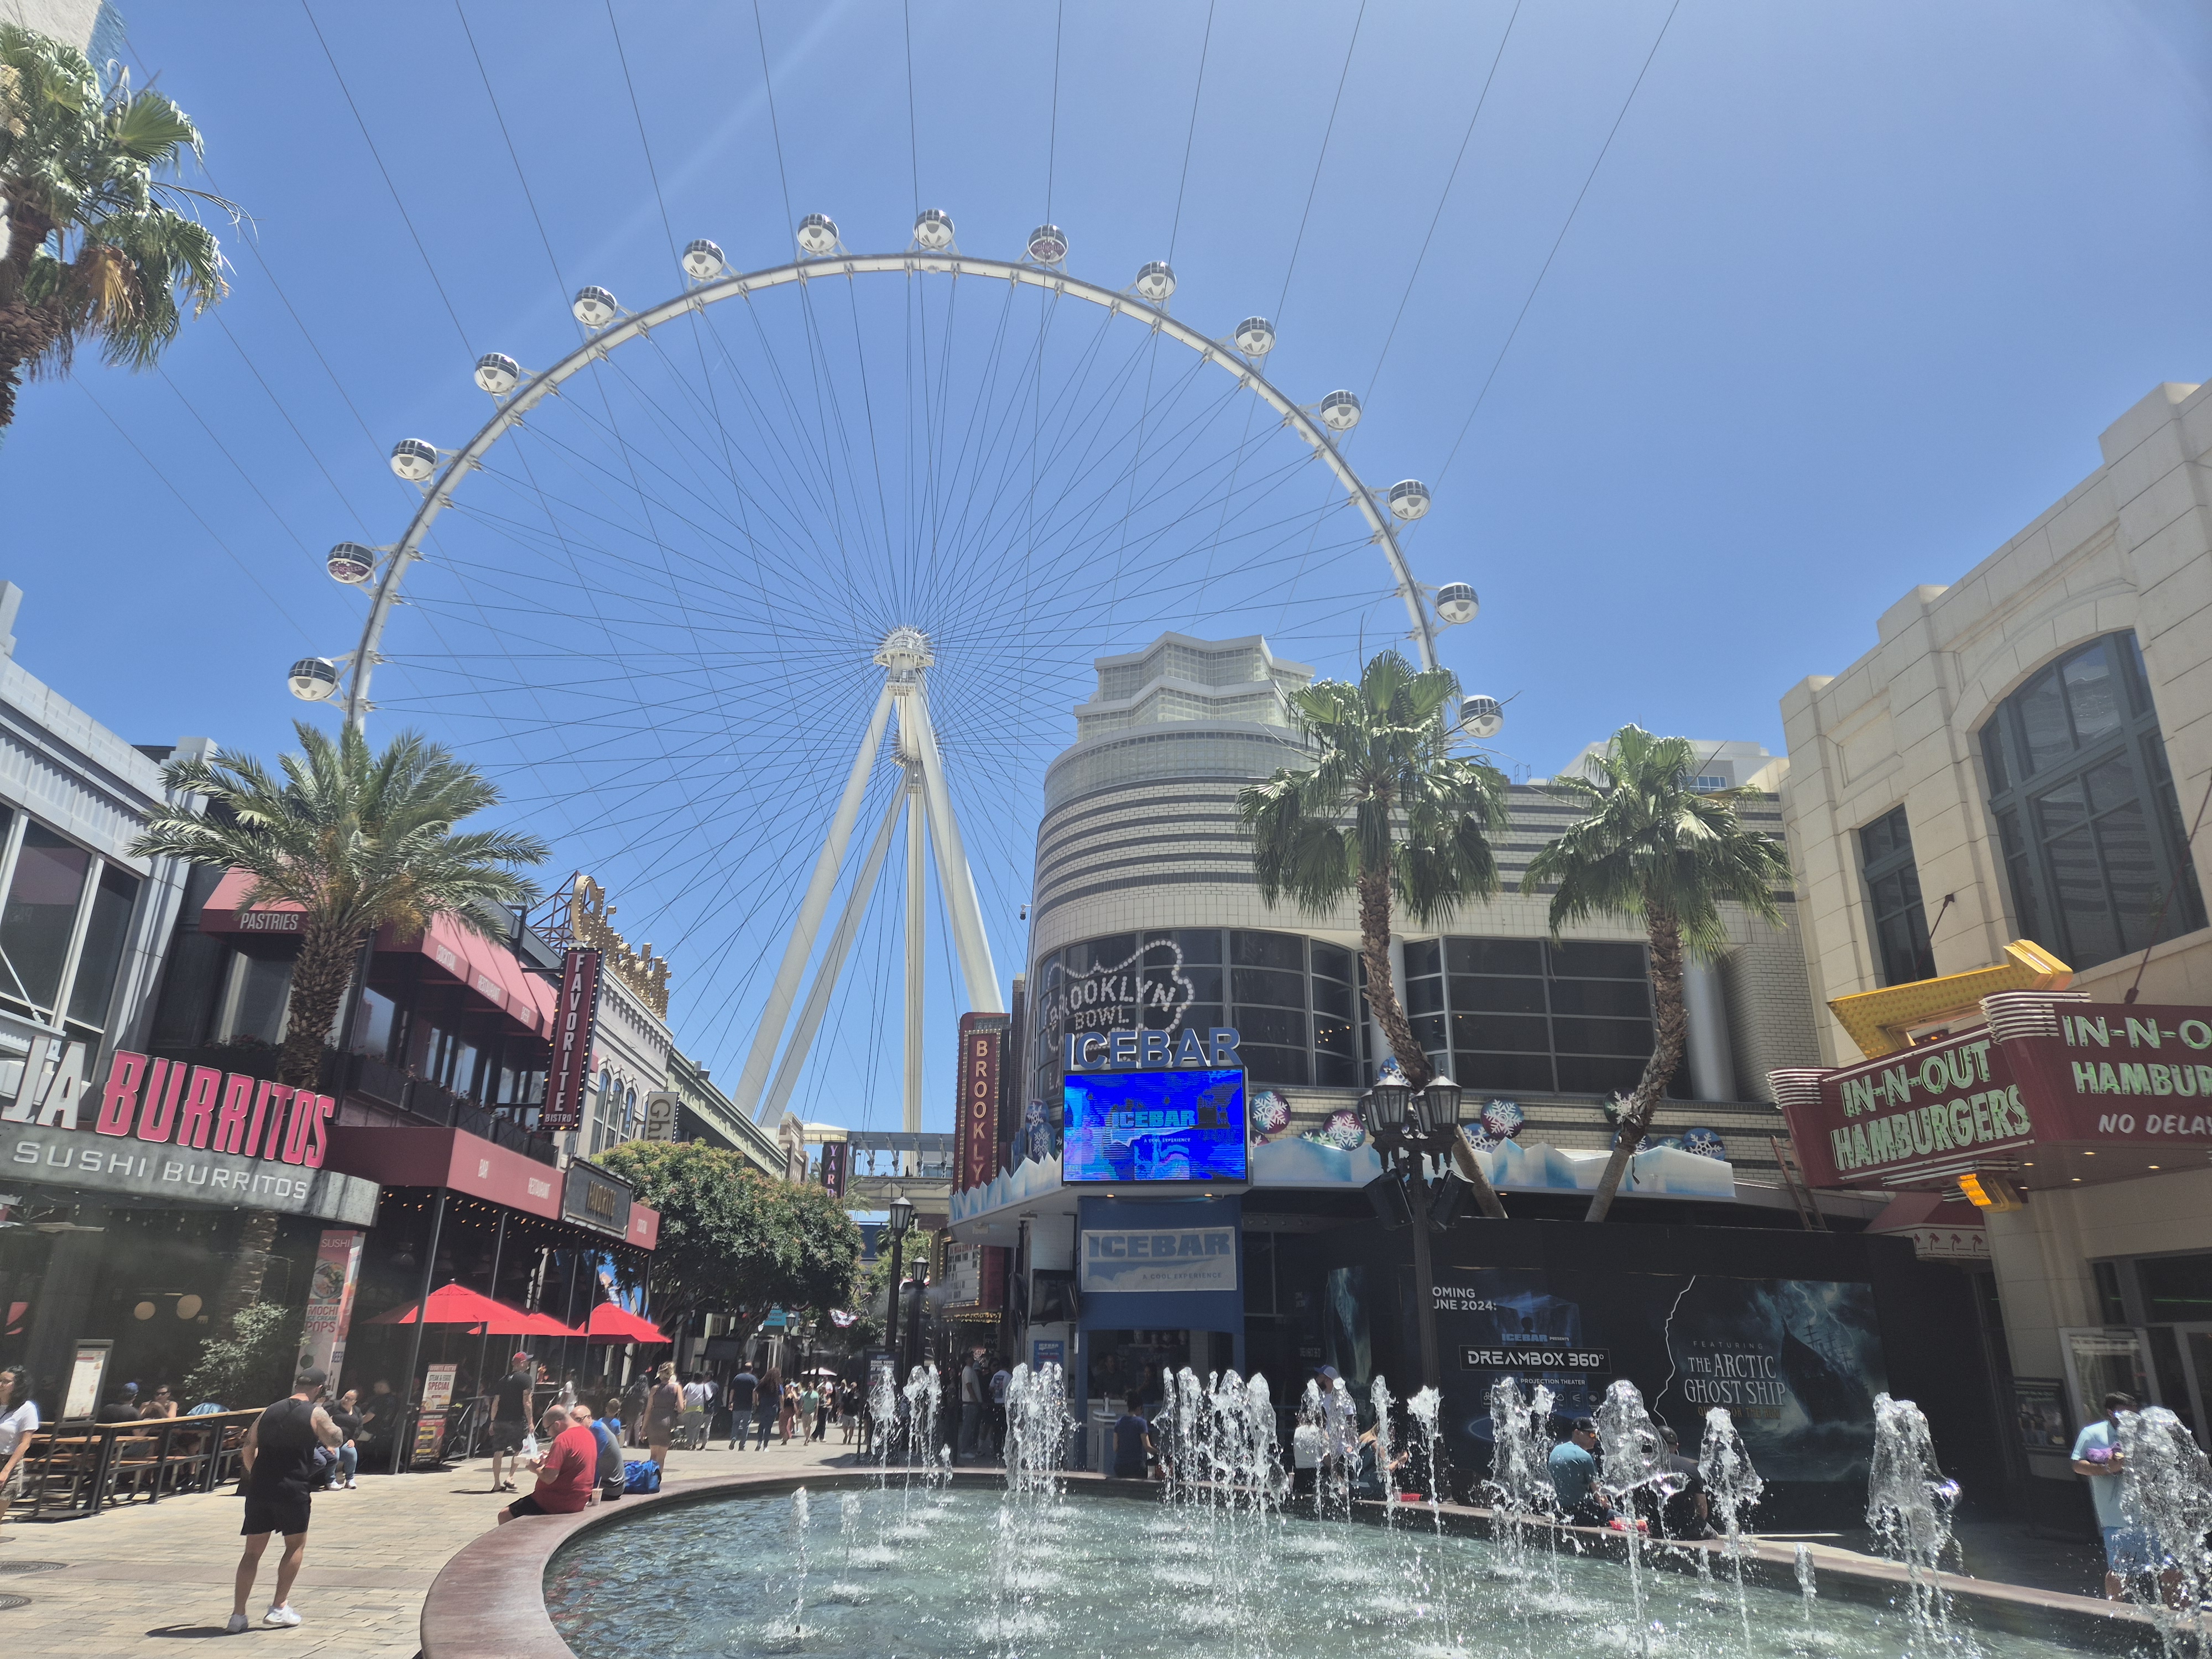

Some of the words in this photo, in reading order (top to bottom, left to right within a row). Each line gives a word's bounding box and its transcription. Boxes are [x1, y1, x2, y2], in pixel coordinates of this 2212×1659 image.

[240, 912, 299, 931] PASTRIES
[1074, 1005, 1129, 1030] BOWL
[554, 954, 585, 1112] FAVORITE
[1064, 1027, 1245, 1071] ICEBAR
[1840, 1039, 1991, 1118] IN-N-OUT
[545, 1113, 572, 1123] BISTRO
[972, 1040, 988, 1188] BROOKLY
[1112, 1110, 1196, 1128] ICEBAR
[1831, 1083, 2032, 1171] HAMBURGERS
[2098, 1113, 2136, 1134] NO
[13, 1140, 147, 1177] SUSHI
[163, 1161, 307, 1200] BURRITOS
[321, 1238, 351, 1248] SUSHI
[1088, 1233, 1230, 1258] ICEBAR
[1432, 1286, 1475, 1298] OMING
[307, 1306, 339, 1316] MOCHI
[1461, 1300, 1497, 1311] 2024:
[305, 1321, 336, 1333] POPS
[1501, 1333, 1548, 1342] ICEBAR
[1693, 1340, 1764, 1349] FEATURING
[1468, 1350, 1565, 1366] DREAMBOX
[1688, 1357, 1712, 1373] THE
[1713, 1353, 1776, 1379] ARCTIC
[427, 1381, 450, 1391] SPECIAL
[1684, 1379, 1743, 1404] GHOST
[1745, 1381, 1786, 1405] SHIP
[1730, 1407, 1743, 1417] OR
